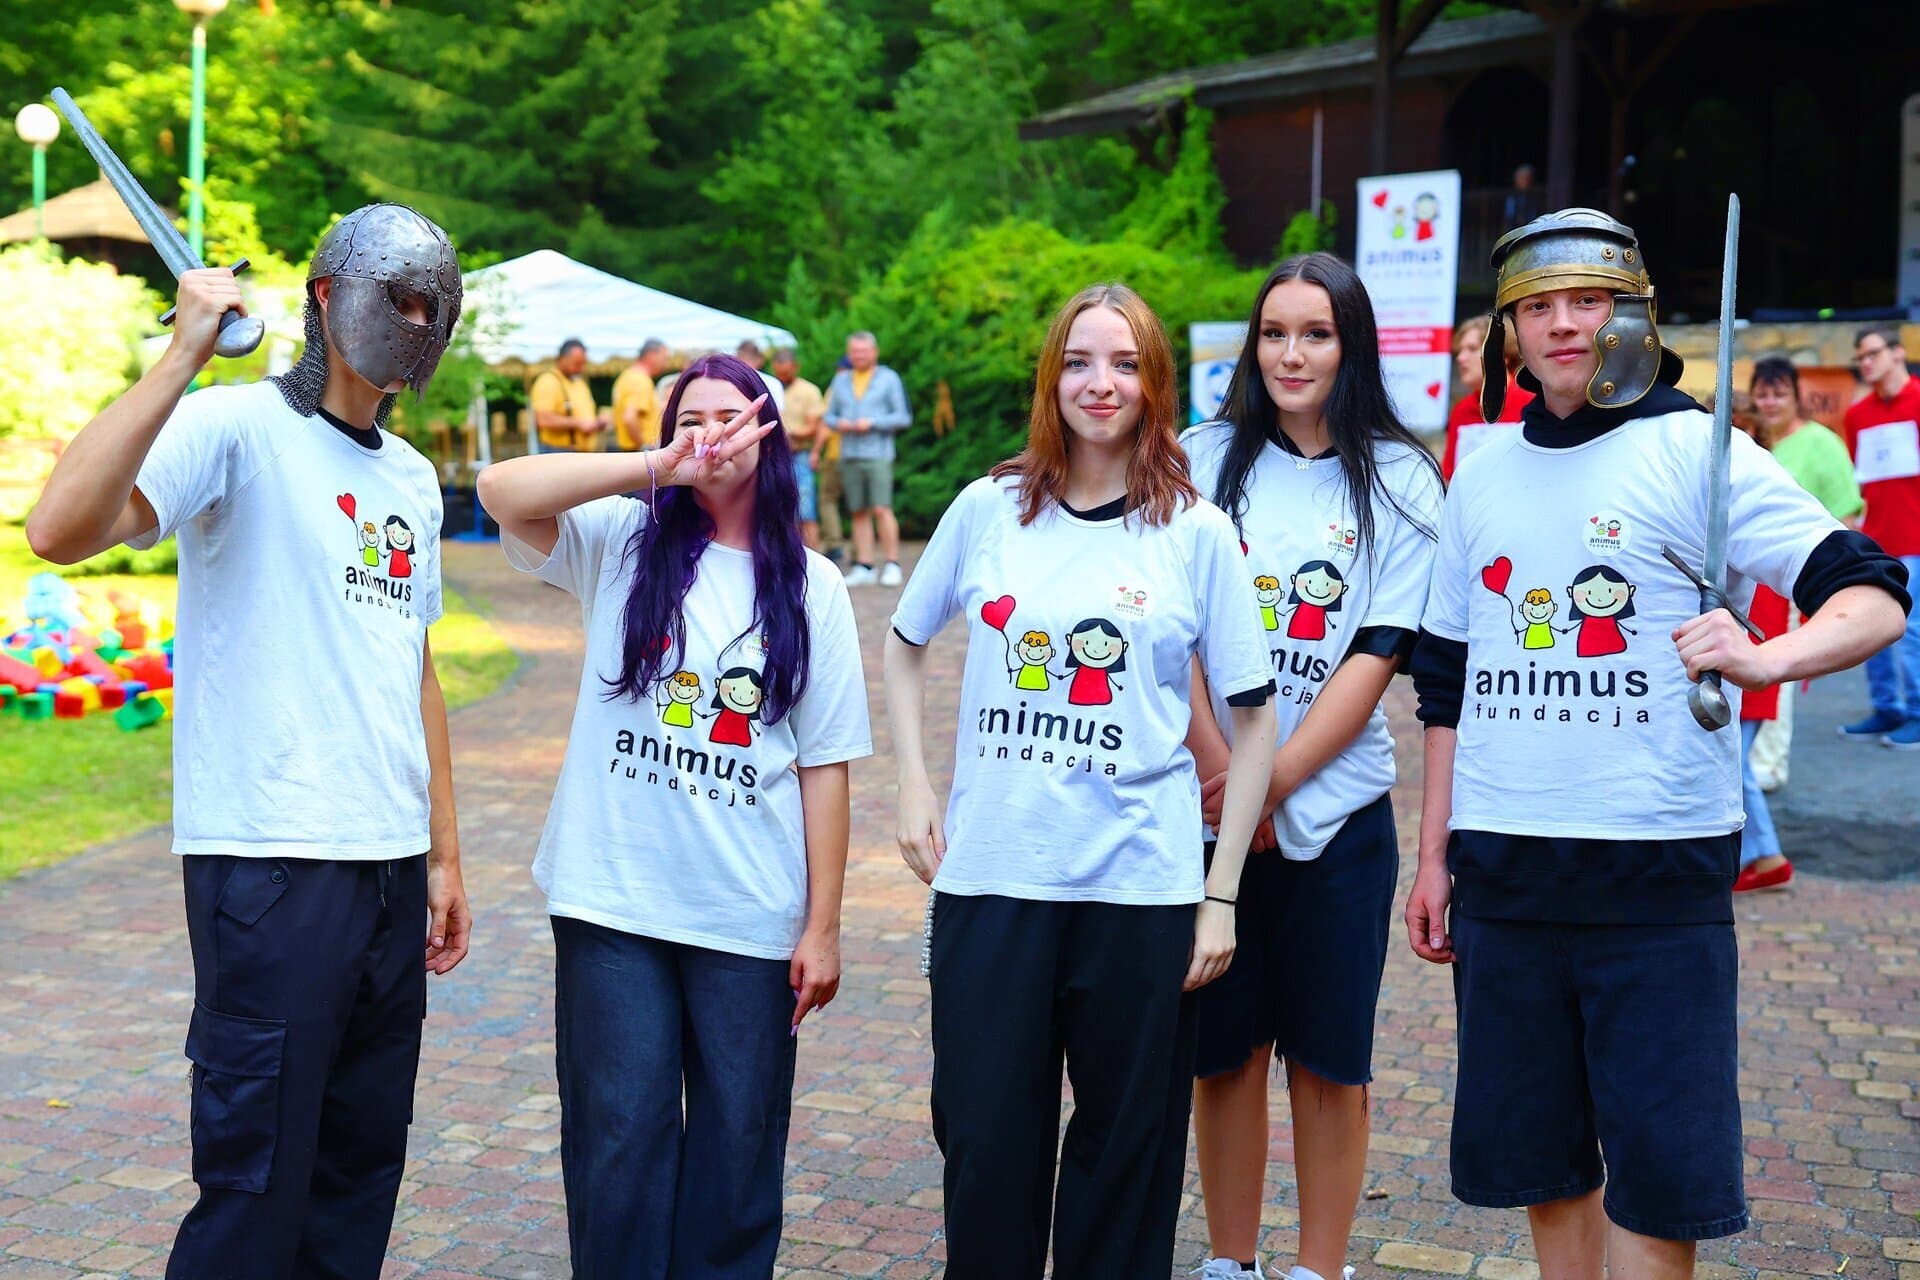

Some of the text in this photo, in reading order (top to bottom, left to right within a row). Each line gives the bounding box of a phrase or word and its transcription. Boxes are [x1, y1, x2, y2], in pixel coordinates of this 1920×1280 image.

[1589, 537, 1621, 545] animus
[345, 566, 412, 602] animus
[1475, 661, 1649, 698] animus
[1475, 703, 1649, 727] fundacja
[615, 729, 758, 789] animus
[978, 744, 1117, 776] undacja
[610, 759, 756, 807] fundacja
